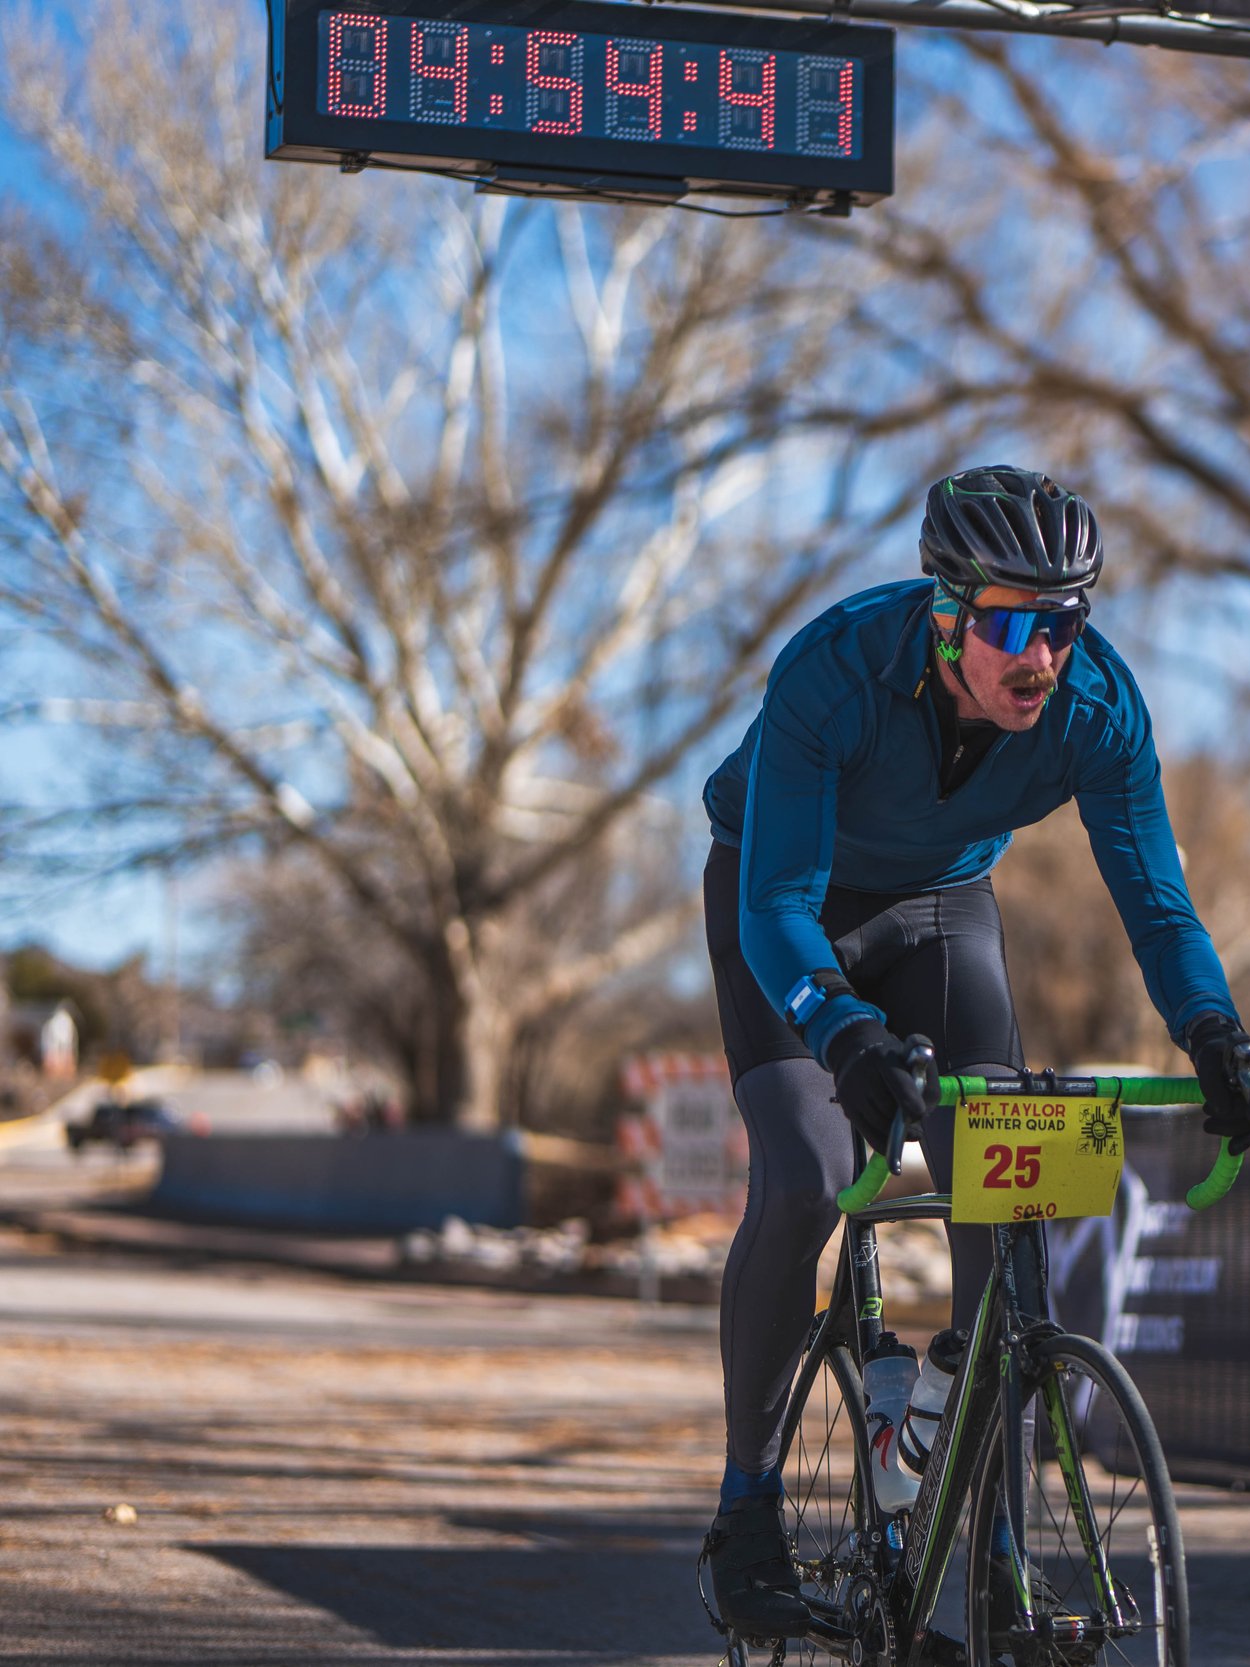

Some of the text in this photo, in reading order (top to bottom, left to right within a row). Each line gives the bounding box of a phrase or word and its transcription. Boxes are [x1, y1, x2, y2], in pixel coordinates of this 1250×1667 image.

[327, 12, 855, 158] 04:54:41
[968, 1102, 1066, 1117] MT. TAYLOR
[968, 1116, 1066, 1131] WINTER QUAD
[983, 1144, 1042, 1189] 25
[1012, 1202, 1057, 1220] SOLO
[905, 1415, 951, 1590] RALEIGH
